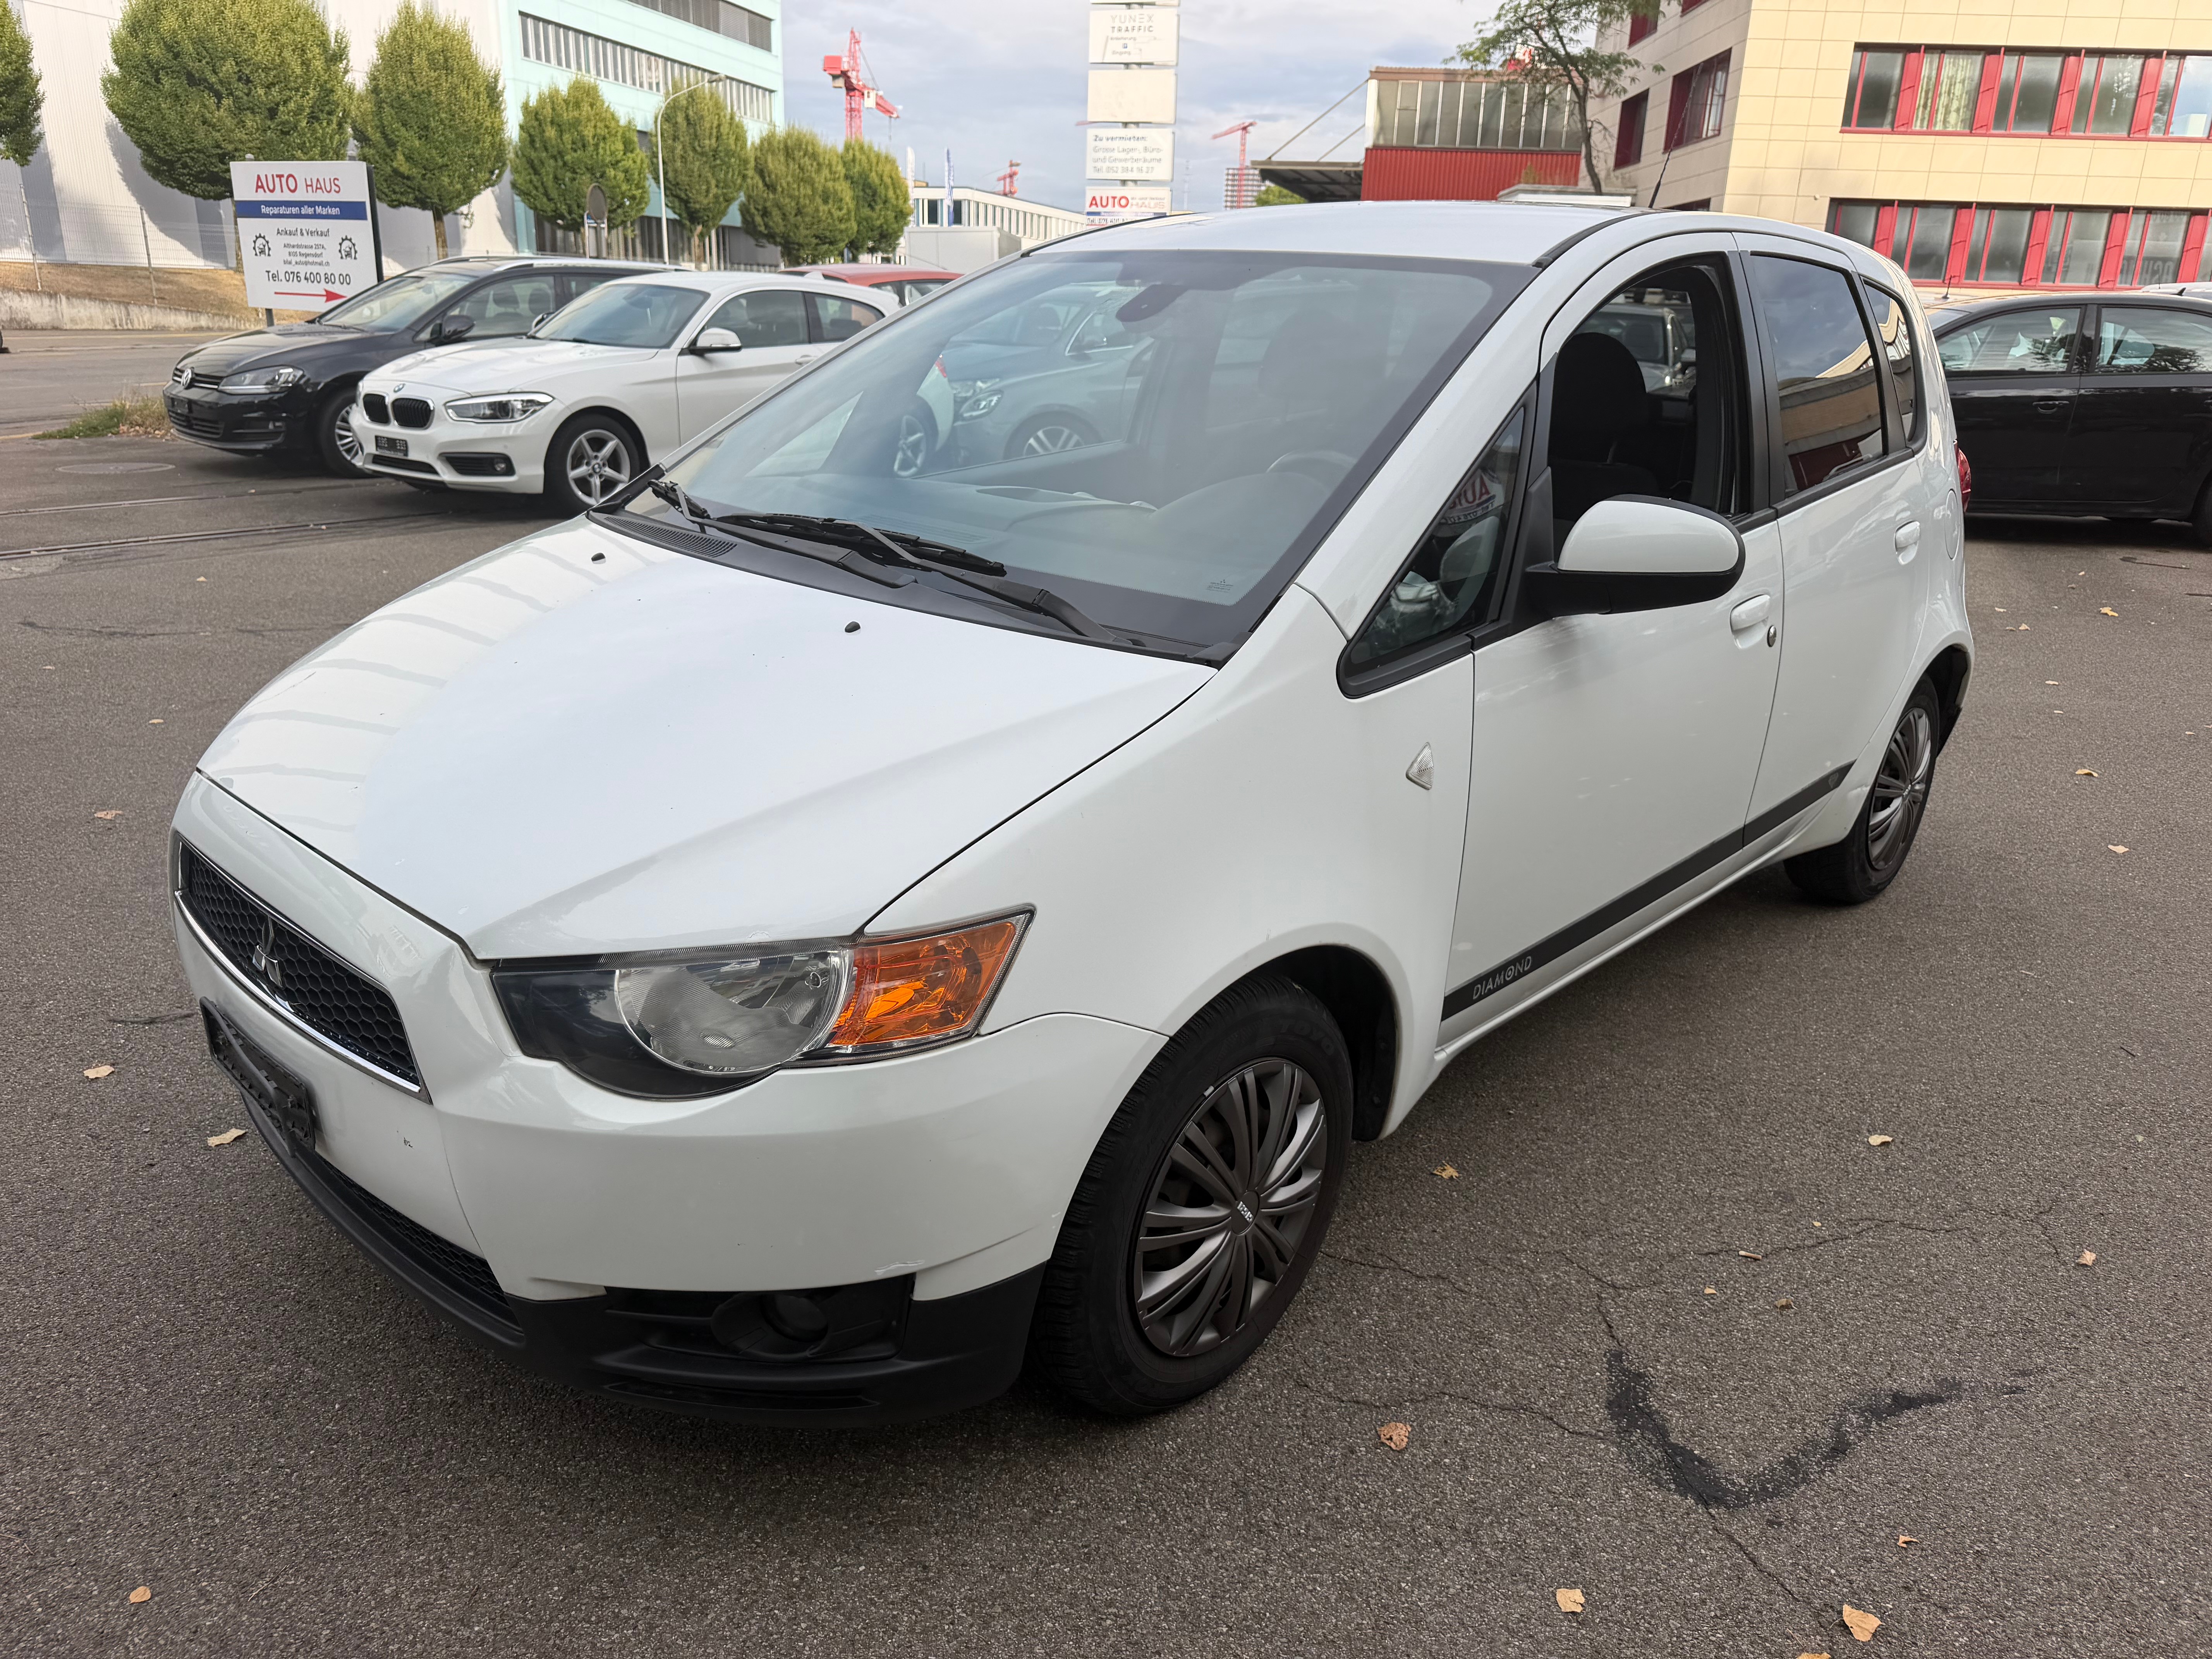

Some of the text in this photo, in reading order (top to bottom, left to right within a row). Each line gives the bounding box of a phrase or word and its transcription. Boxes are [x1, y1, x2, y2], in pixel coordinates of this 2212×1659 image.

[1110, 14, 1154, 23] YUNEX
[255, 173, 341, 193] AUTO HAUS
[1089, 196, 1129, 208] AUTO
[261, 205, 340, 216] Reparaturen aller Marken
[276, 227, 330, 237] Ankauf & Verkauf
[266, 270, 351, 285] Tel. 076 400 80 00
[1473, 956, 1532, 1000] DIAMOND
